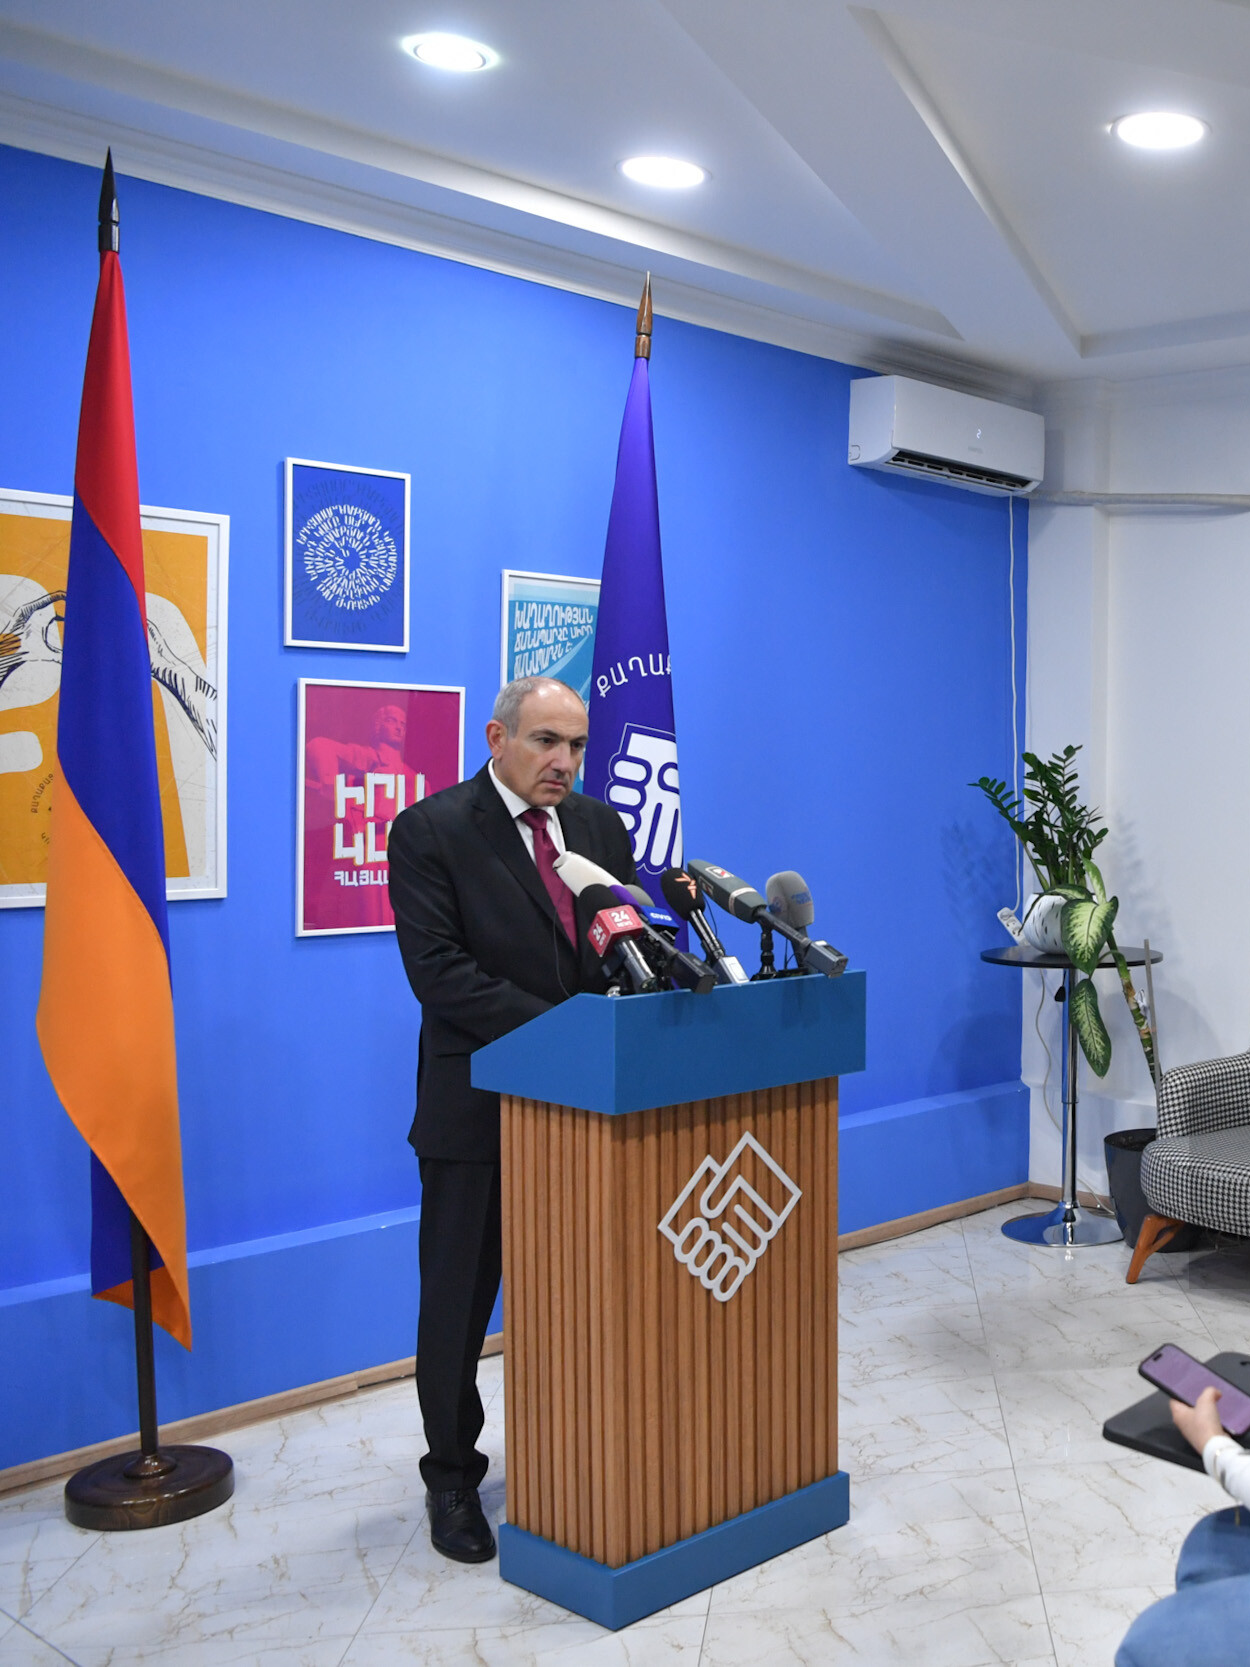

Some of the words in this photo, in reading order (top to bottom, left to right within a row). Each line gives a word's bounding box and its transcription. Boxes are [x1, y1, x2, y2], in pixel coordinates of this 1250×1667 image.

[514, 602, 594, 630] ԽԱՂԱՂՈՒԹՅԱՆ
[514, 627, 568, 653] ՃԱՆԱՊԱՐՀԸ
[611, 910, 630, 923] 24
[593, 923, 604, 942] 24
